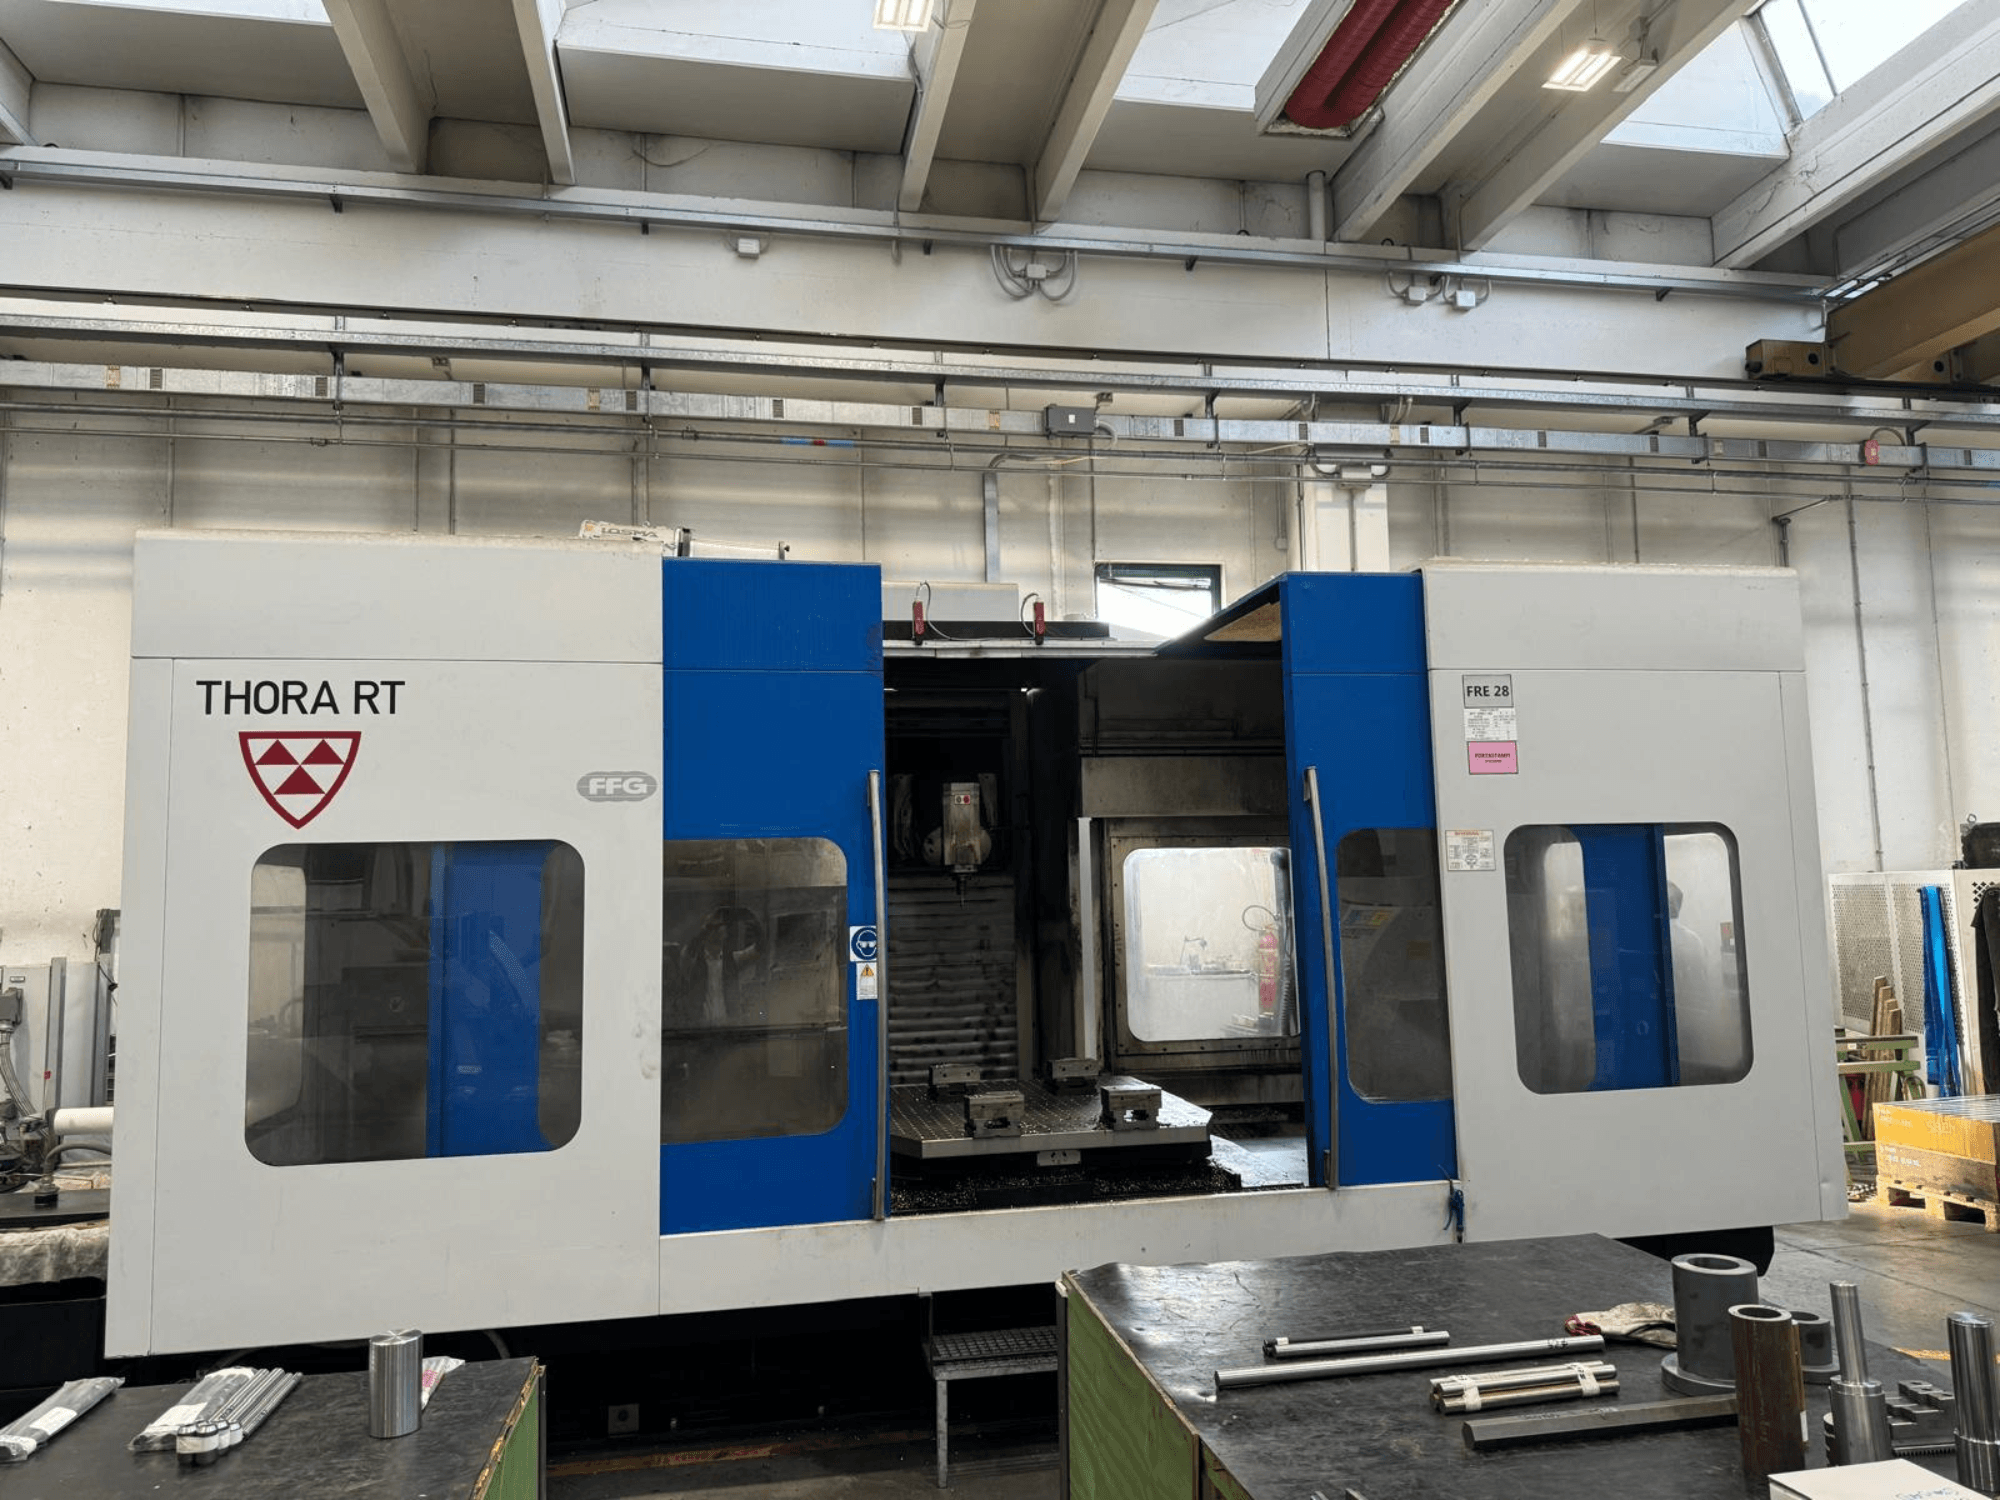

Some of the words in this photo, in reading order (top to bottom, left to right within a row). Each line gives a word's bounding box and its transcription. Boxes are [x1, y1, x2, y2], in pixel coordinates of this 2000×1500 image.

[196, 680, 339, 715] THORA
[354, 680, 406, 715] RT
[1466, 685, 1490, 697] FRE
[1494, 685, 1510, 697] 28
[589, 777, 647, 795] FFG
